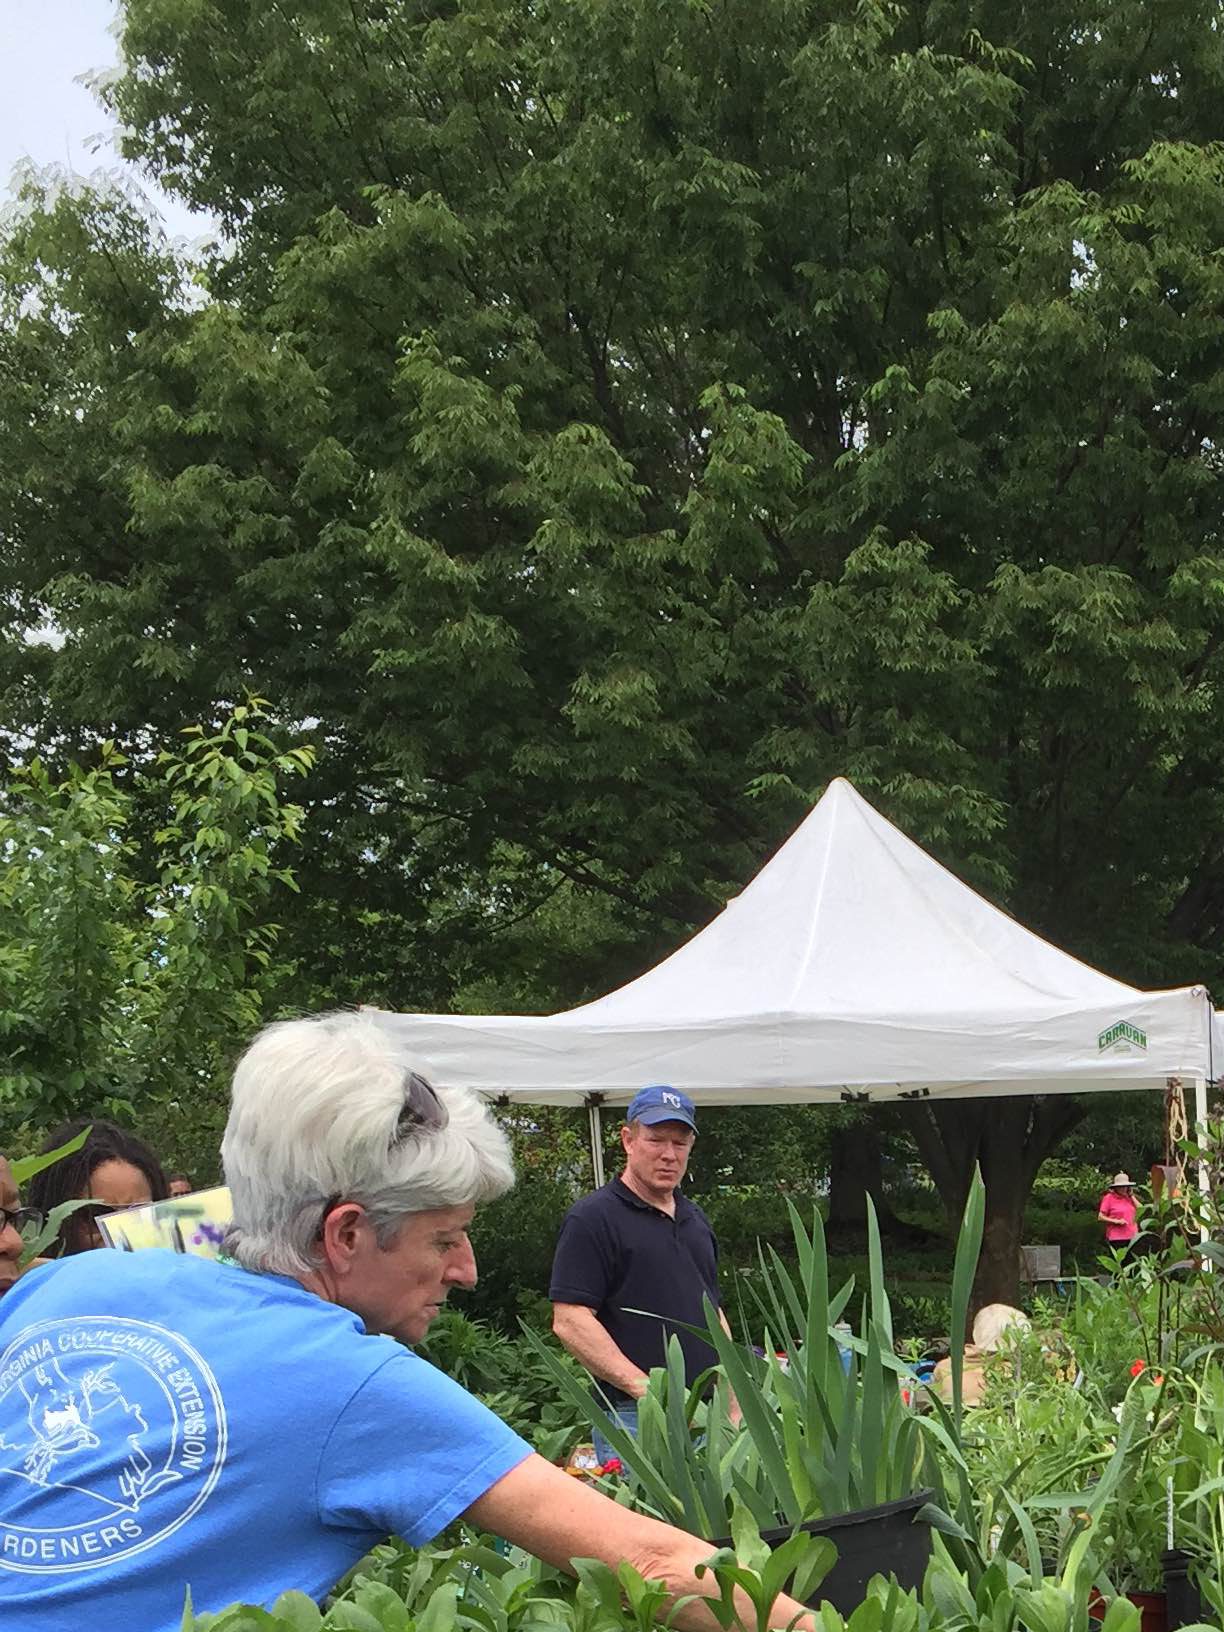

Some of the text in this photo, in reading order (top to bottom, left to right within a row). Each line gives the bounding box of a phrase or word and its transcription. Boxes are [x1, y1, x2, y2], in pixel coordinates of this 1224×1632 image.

[1099, 1022, 1146, 1048] CARAVAN
[0, 1338, 55, 1392] RGINIA
[167, 1367, 207, 1471] EXTENSION
[3, 1518, 142, 1558] RDENERS
